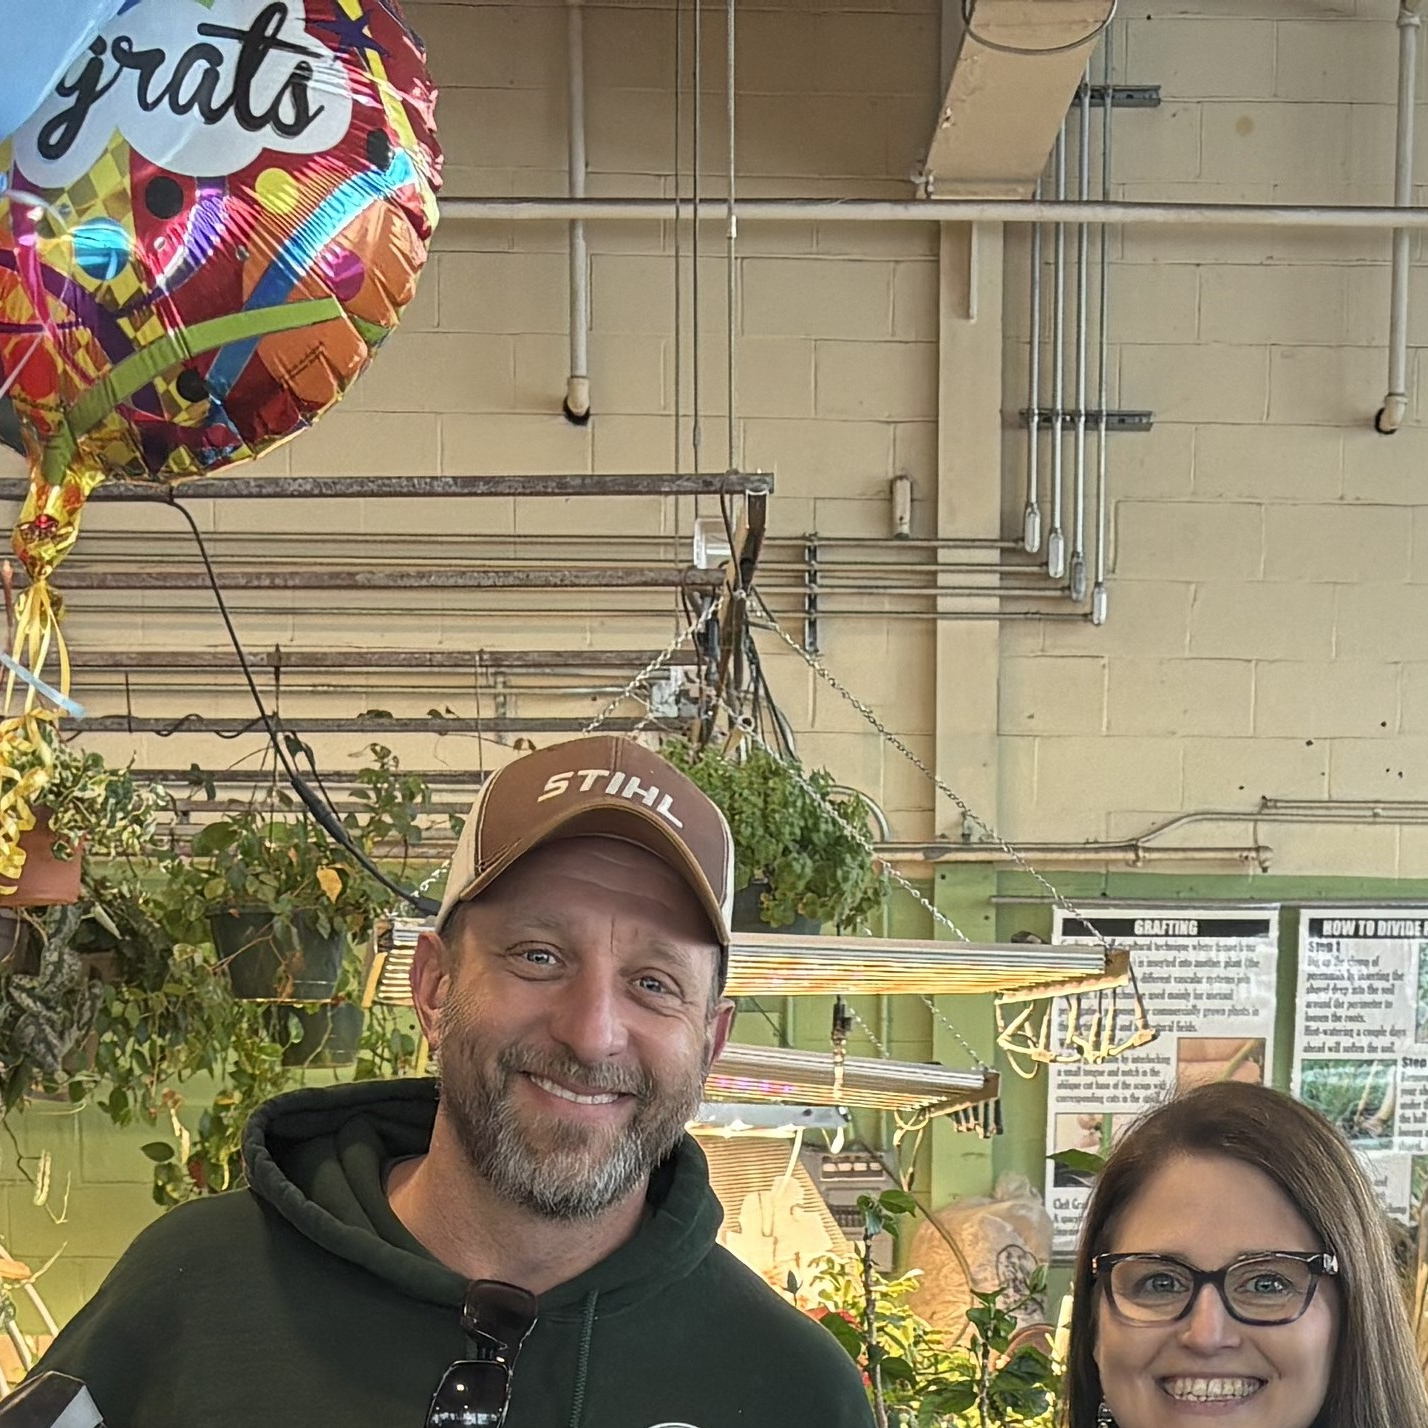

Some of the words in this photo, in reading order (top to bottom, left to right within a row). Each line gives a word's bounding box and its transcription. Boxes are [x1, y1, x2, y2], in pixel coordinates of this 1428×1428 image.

[37, 0, 326, 161] grats
[537, 769, 683, 829] STIHL
[1133, 919, 1199, 936] GRAFTING
[1322, 920, 1356, 937] HOW
[1357, 920, 1375, 937] TO
[1377, 920, 1422, 937] DIVIDE
[1308, 940, 1333, 953] Step
[1401, 1056, 1427, 1069] Step
